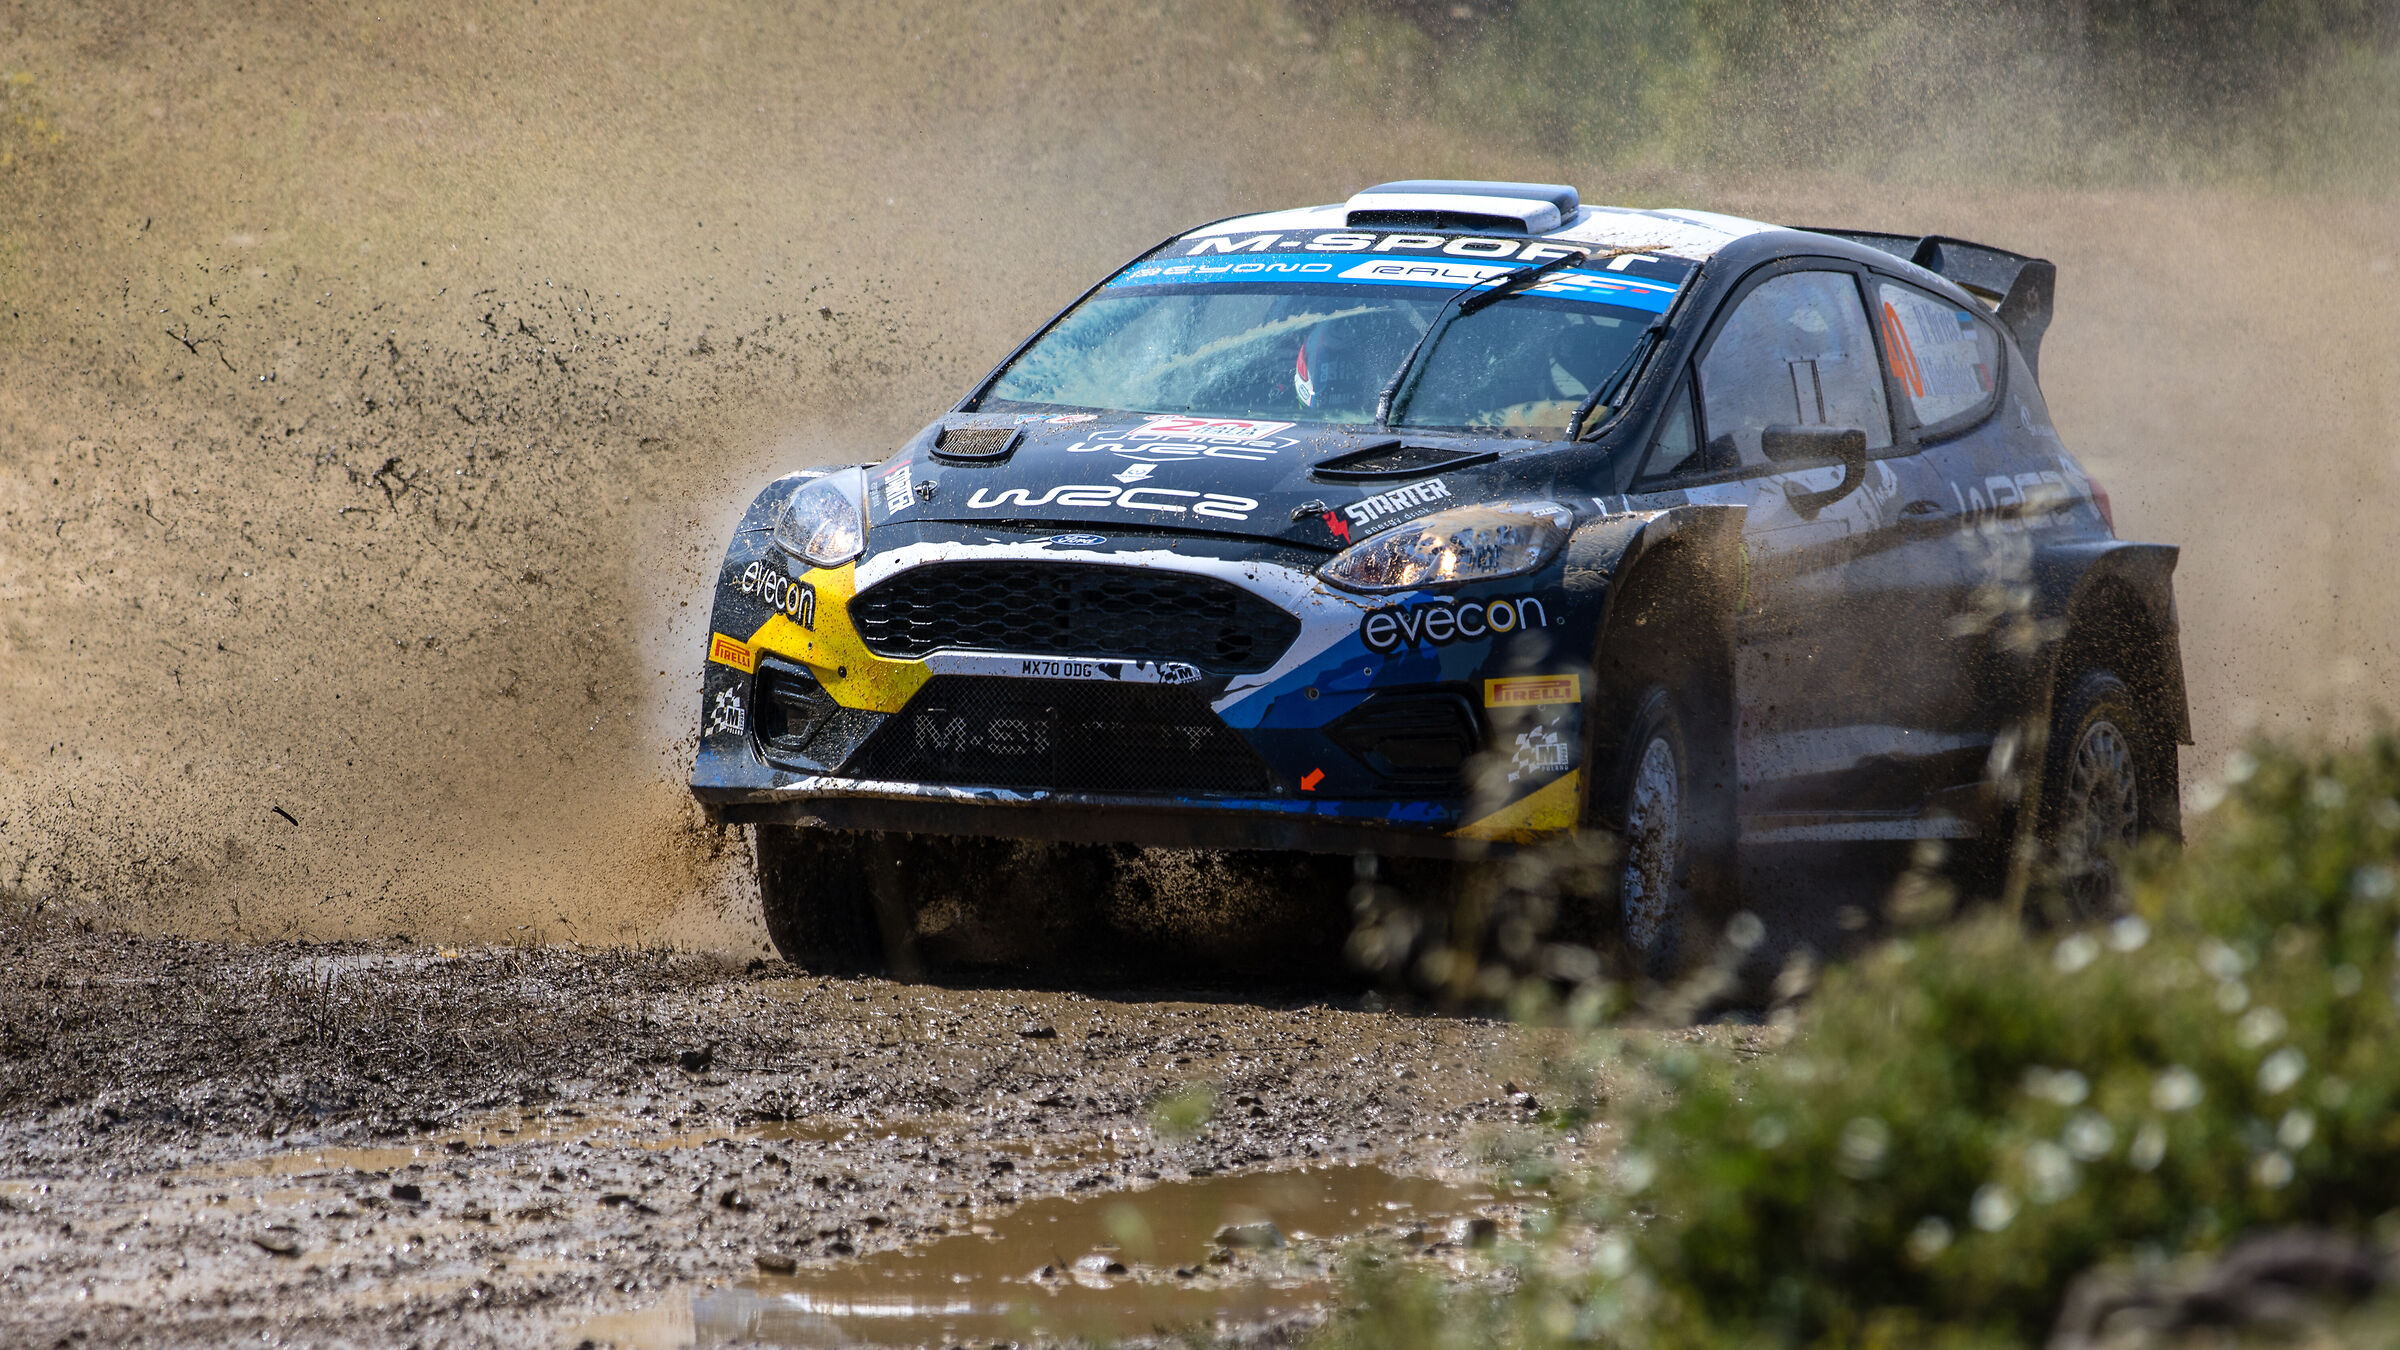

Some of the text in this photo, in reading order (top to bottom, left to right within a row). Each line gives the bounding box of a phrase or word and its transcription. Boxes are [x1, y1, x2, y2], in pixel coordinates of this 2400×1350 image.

[1186, 233, 1660, 271] M-SPORT
[1129, 262, 1333, 279] BEYOND
[1876, 301, 1924, 399] 40
[1066, 441, 1278, 461] WRC
[966, 486, 1259, 521] WRC2
[1344, 477, 1452, 527] STARTER
[1364, 506, 1434, 535] energy drink
[1058, 535, 1098, 544] Ford
[742, 561, 813, 624] evecon
[1366, 597, 1548, 648] evecon
[714, 638, 751, 668] PIRELLI
[1022, 660, 1059, 676] MX70
[1494, 680, 1571, 703] PIRELLI
[1537, 744, 1559, 765] M
